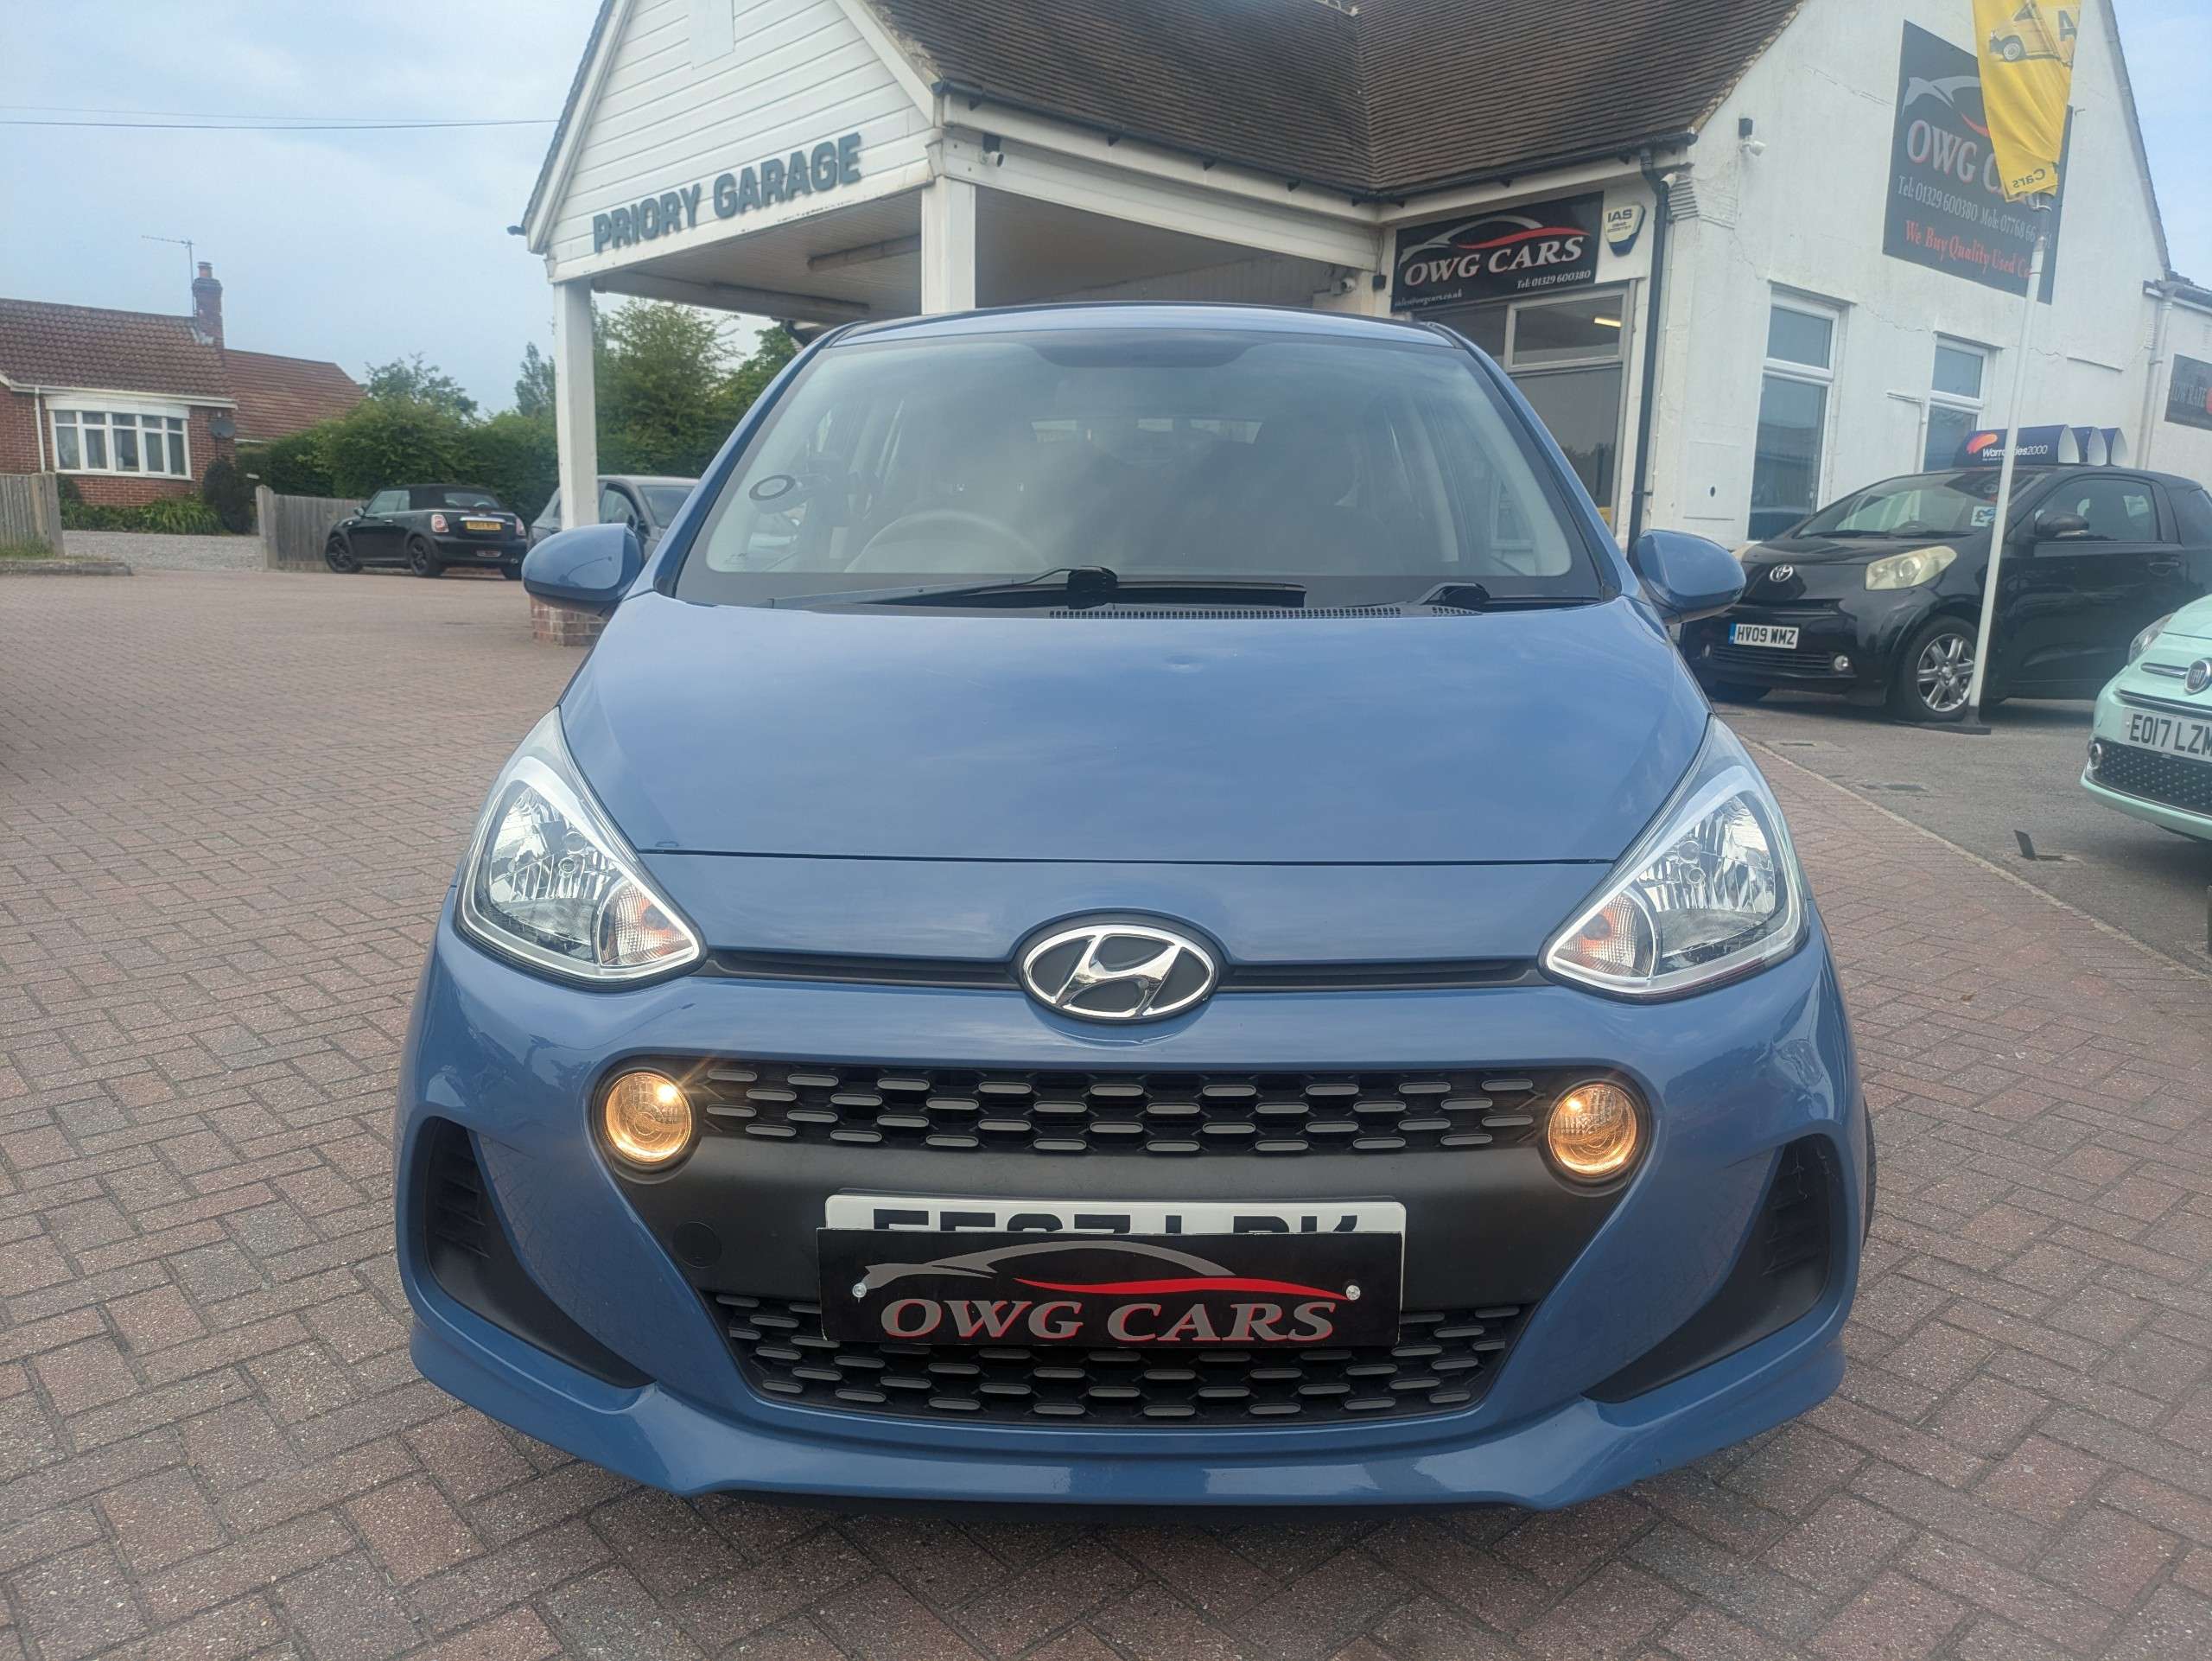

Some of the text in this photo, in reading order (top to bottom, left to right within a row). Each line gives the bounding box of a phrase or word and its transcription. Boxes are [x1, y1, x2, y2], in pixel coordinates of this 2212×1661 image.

[1907, 119, 1978, 184] OWG
[593, 131, 862, 254] PRIORY GARAGE
[1607, 208, 1632, 223] IAS
[1404, 236, 1585, 286] OWG CARS
[1905, 220, 1922, 245] We
[1924, 226, 1948, 262] Buy
[1949, 234, 1989, 275] Quality
[1531, 274, 1555, 287] 01329
[1556, 269, 1592, 283] 600380
[1737, 626, 1796, 645] HV09 WMZ
[880, 1298, 1336, 1342] OWG CARS
